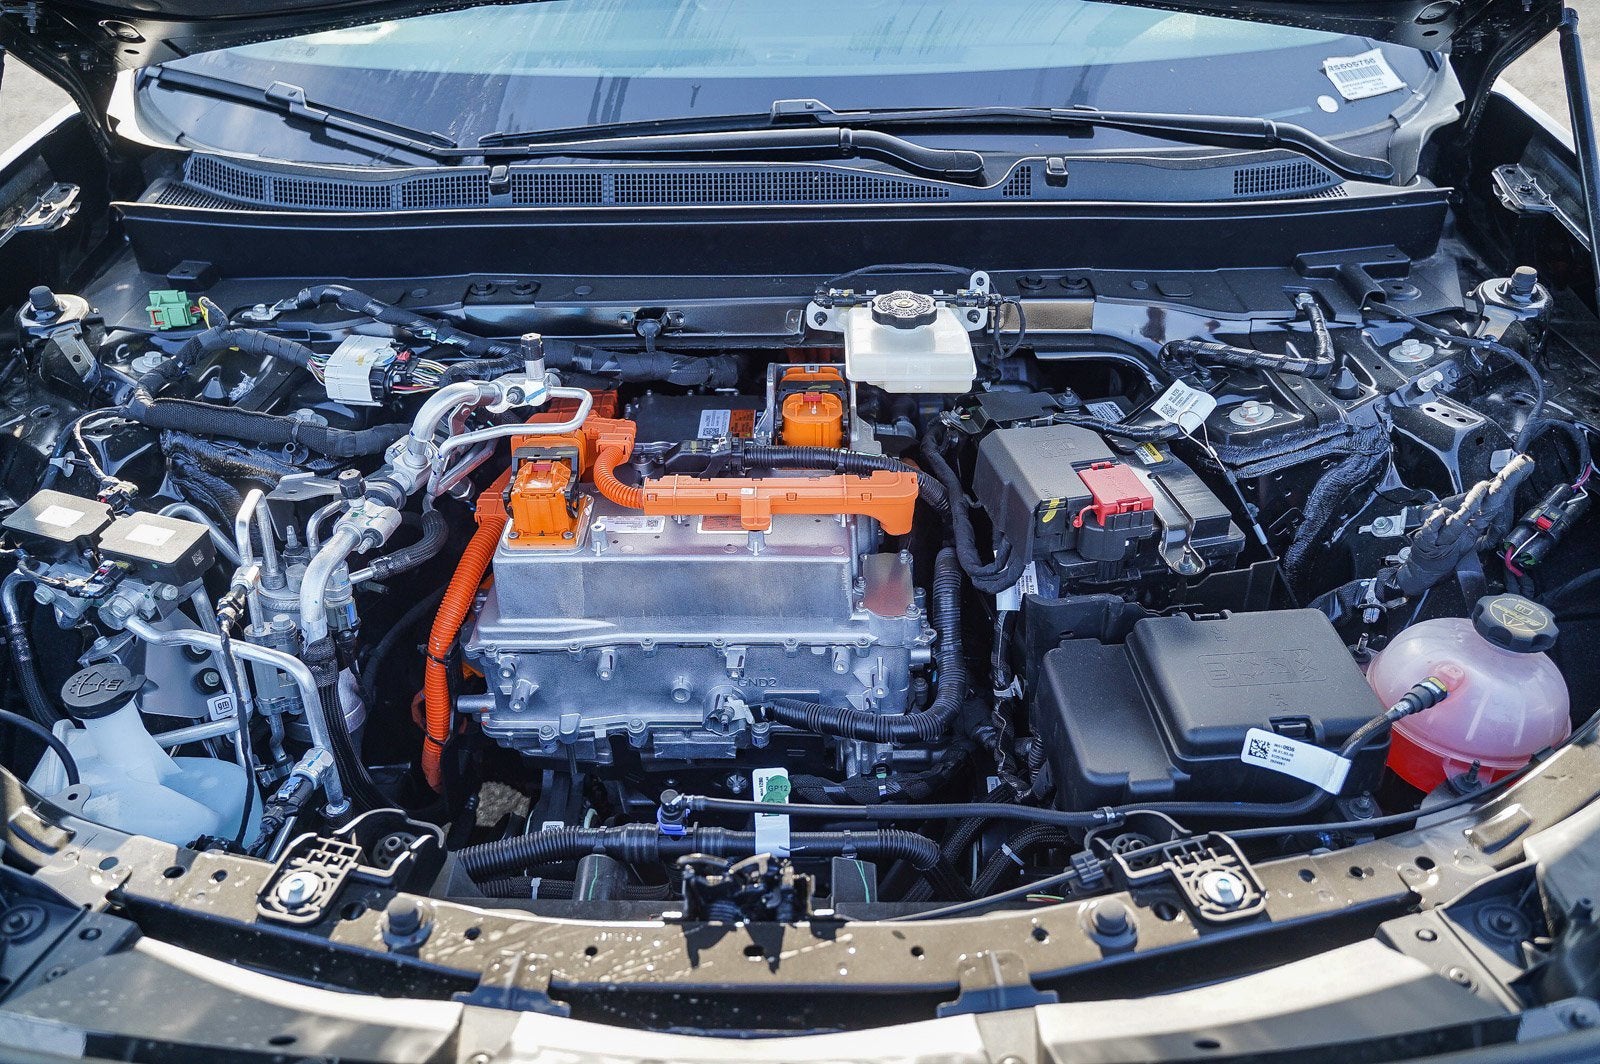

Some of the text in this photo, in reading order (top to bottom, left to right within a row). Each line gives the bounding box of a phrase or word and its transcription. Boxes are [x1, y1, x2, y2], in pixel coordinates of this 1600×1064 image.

[737, 677, 777, 688] GND2
[217, 700, 230, 711] gm
[767, 784, 788, 792] GP12
